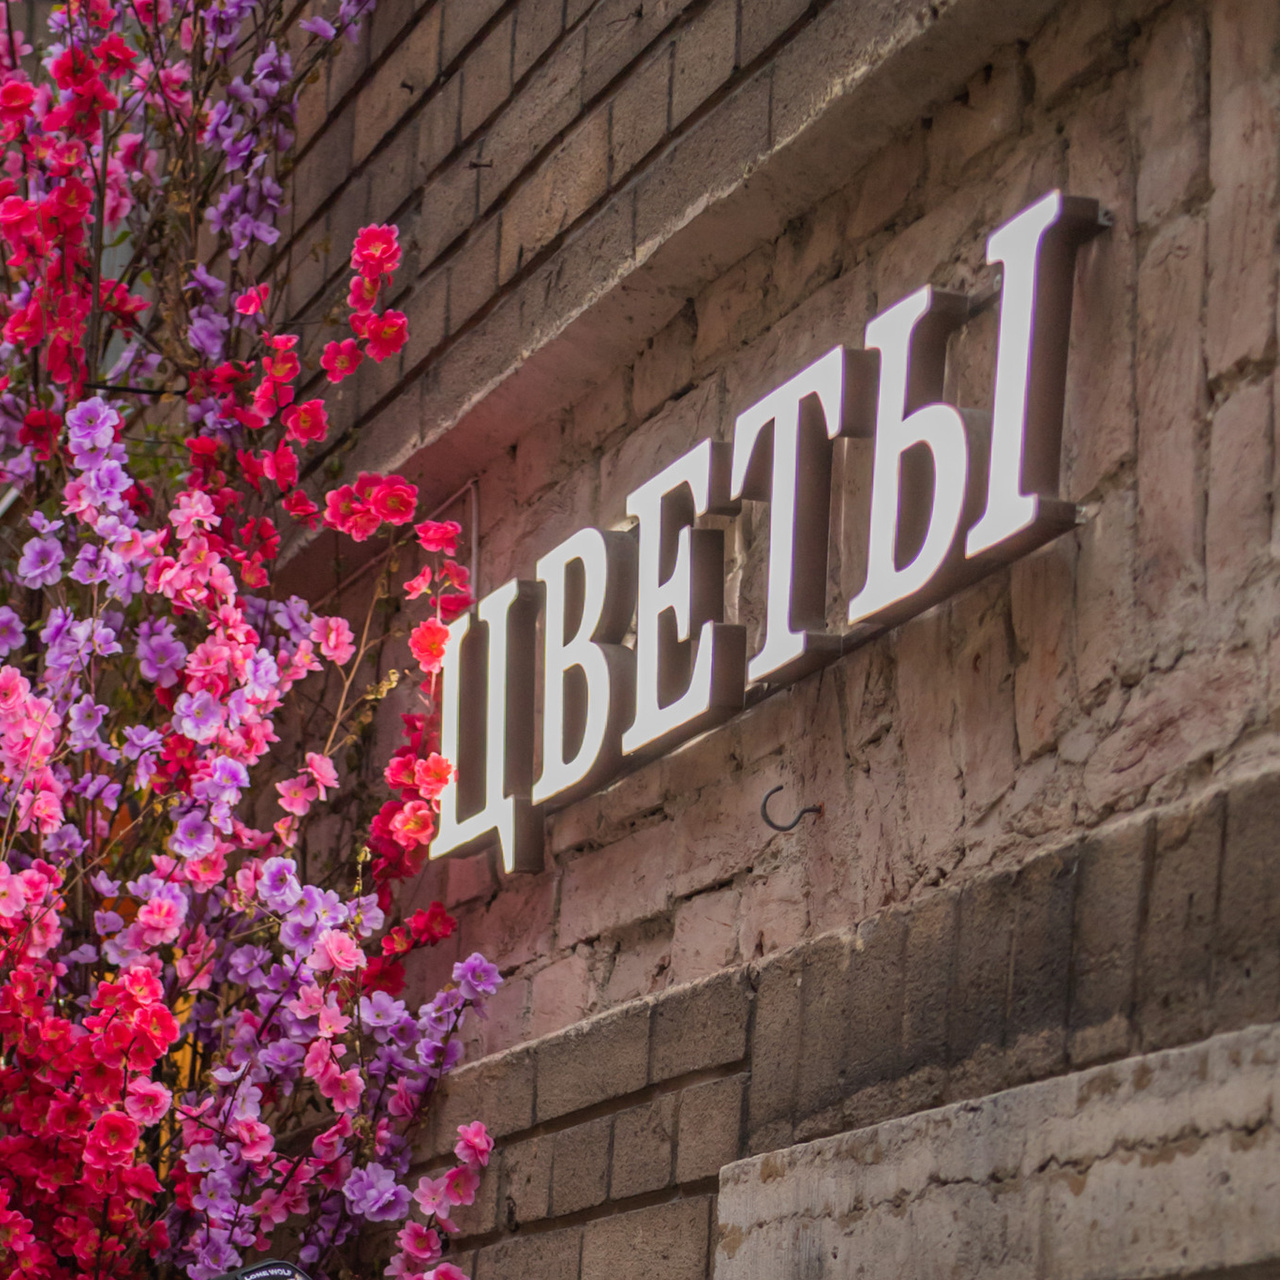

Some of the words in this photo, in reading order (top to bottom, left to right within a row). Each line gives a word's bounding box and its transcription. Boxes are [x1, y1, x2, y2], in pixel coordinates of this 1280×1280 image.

[429, 189, 1063, 873] ЦВЕТЫ
[244, 1270, 269, 1280] LONE
[268, 1268, 292, 1277] WOLF
